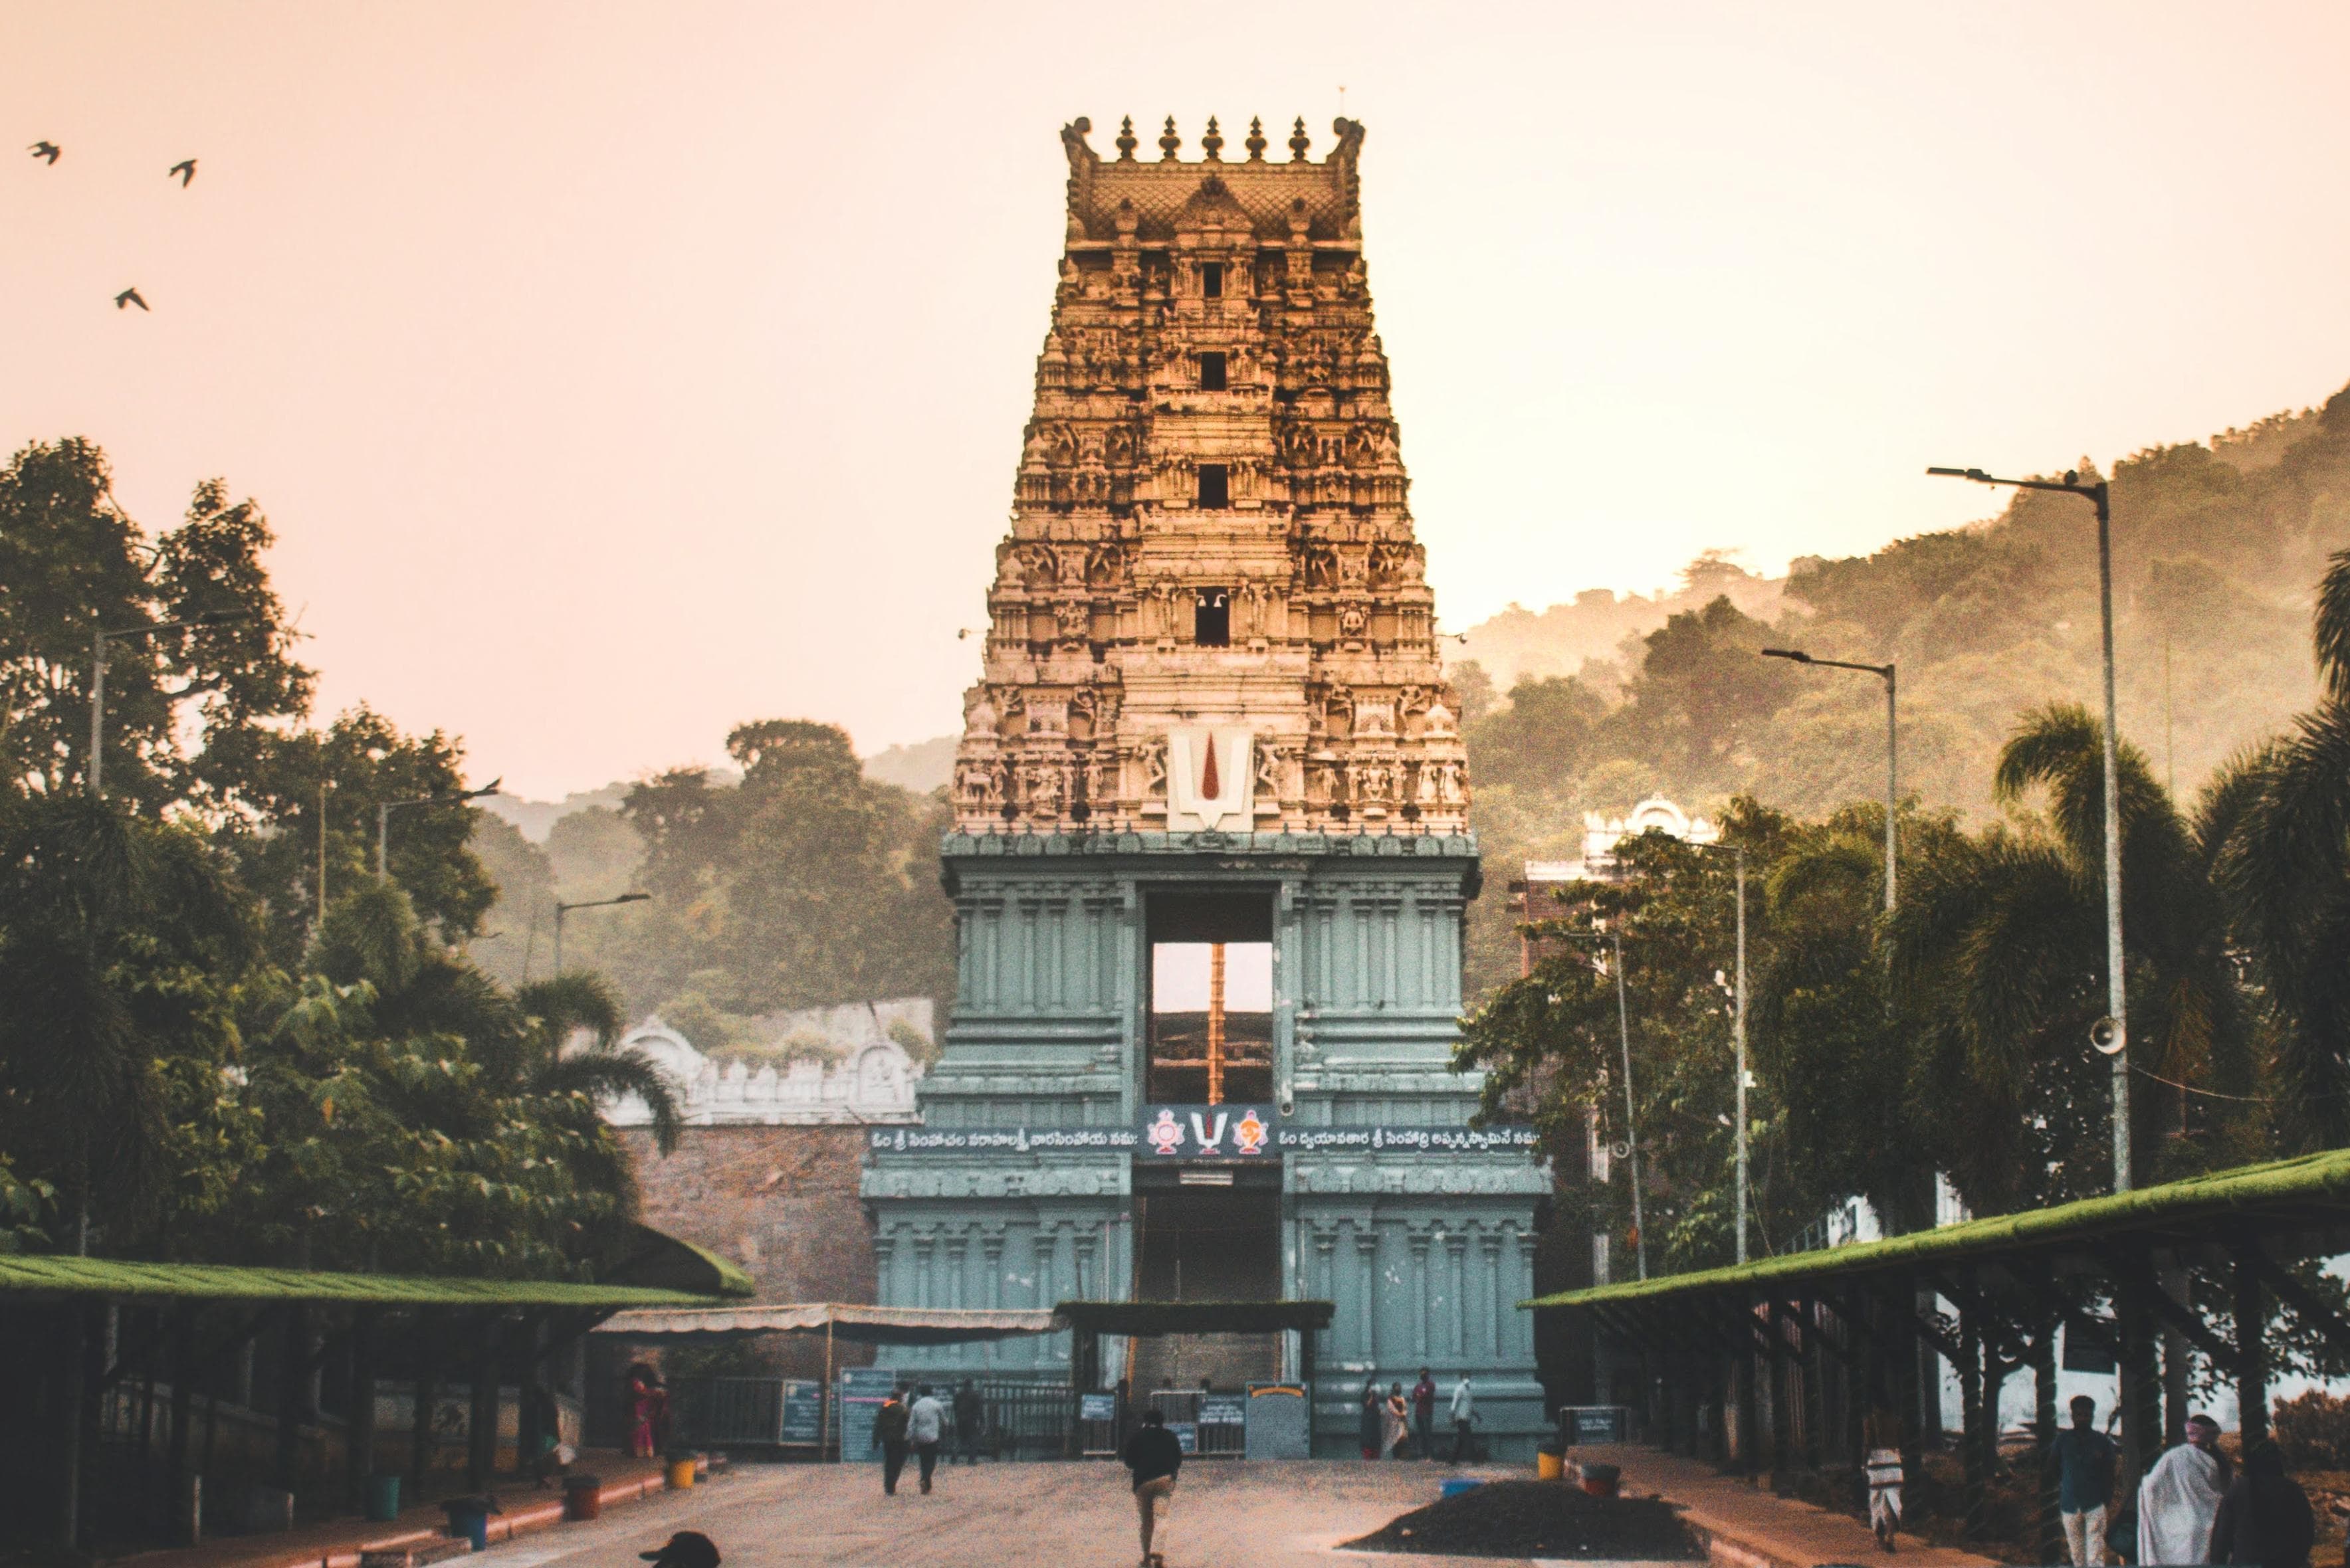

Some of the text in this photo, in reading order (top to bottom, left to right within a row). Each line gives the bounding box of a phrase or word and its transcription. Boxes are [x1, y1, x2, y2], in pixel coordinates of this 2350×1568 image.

[871, 1131, 892, 1147] ఓం
[894, 1129, 907, 1151] శ్రీ
[1279, 1131, 1297, 1144] ఓం
[1372, 1127, 1384, 1148] శ్రీ
[1386, 1131, 1430, 1148] సింహాద్రి
